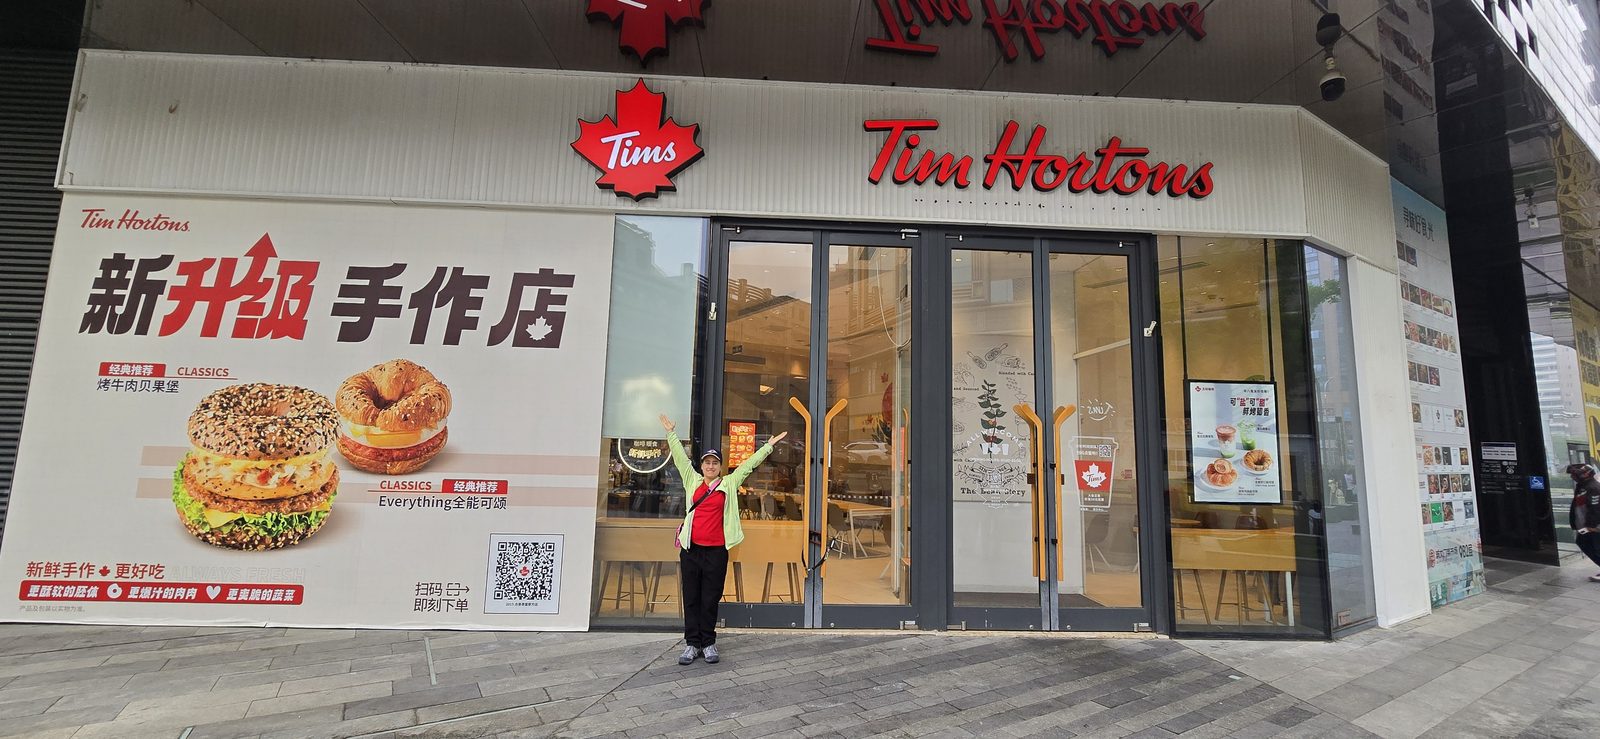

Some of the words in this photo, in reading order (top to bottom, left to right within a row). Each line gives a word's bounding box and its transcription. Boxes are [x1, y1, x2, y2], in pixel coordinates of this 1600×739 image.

[601, 131, 676, 170] Tims
[864, 119, 970, 189] Tim
[982, 120, 1214, 198] Hortons
[81, 209, 113, 229] Tim
[117, 209, 190, 232] Hortons
[78, 233, 321, 341] 新升级
[330, 262, 575, 348] 手作店
[108, 363, 154, 376] 经典推荐
[177, 366, 229, 377] CLASSICS
[96, 378, 180, 394] 烤牛肉贝果堡
[380, 480, 432, 491] CLASSICS
[453, 481, 498, 493] 经典推荐
[26, 561, 96, 578] 新鲜手作
[114, 562, 166, 580] 更好吃
[415, 582, 443, 597] 扫码
[413, 598, 469, 613] 即刻下单
